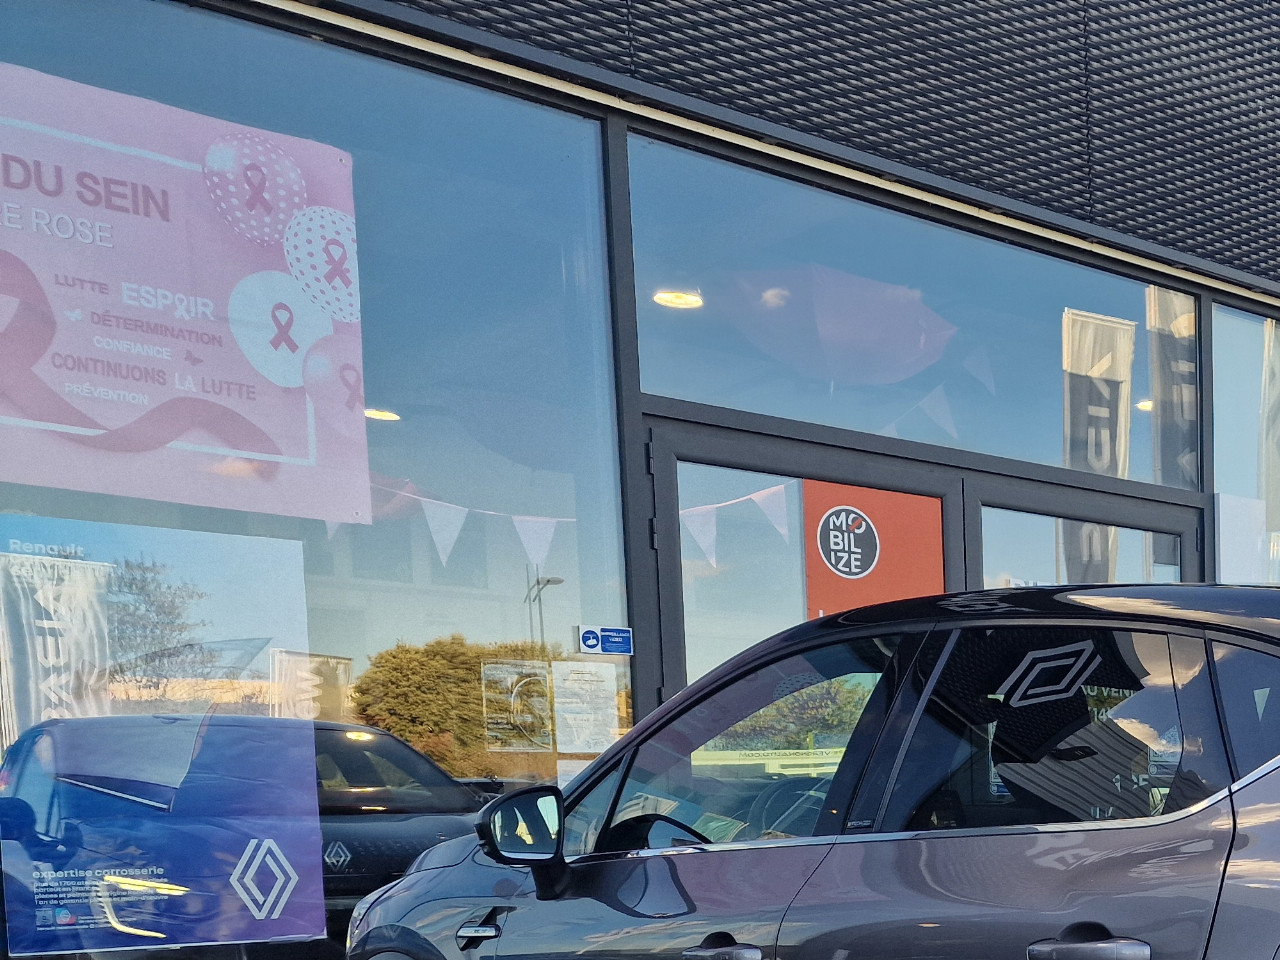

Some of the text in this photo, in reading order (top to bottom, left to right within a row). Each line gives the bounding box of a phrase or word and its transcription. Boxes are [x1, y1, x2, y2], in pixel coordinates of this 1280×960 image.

[1, 153, 170, 222] DU SEIN
[0, 202, 114, 248] E ROSE
[54, 274, 109, 295] LUTTE
[90, 310, 223, 347] DÉTERMINATION
[93, 336, 172, 360] CONFIANCE
[51, 352, 257, 401] CONTINUONS LA LUTTE
[9, 539, 84, 556] Renault
[32, 866, 165, 880] expertise carrosserie
